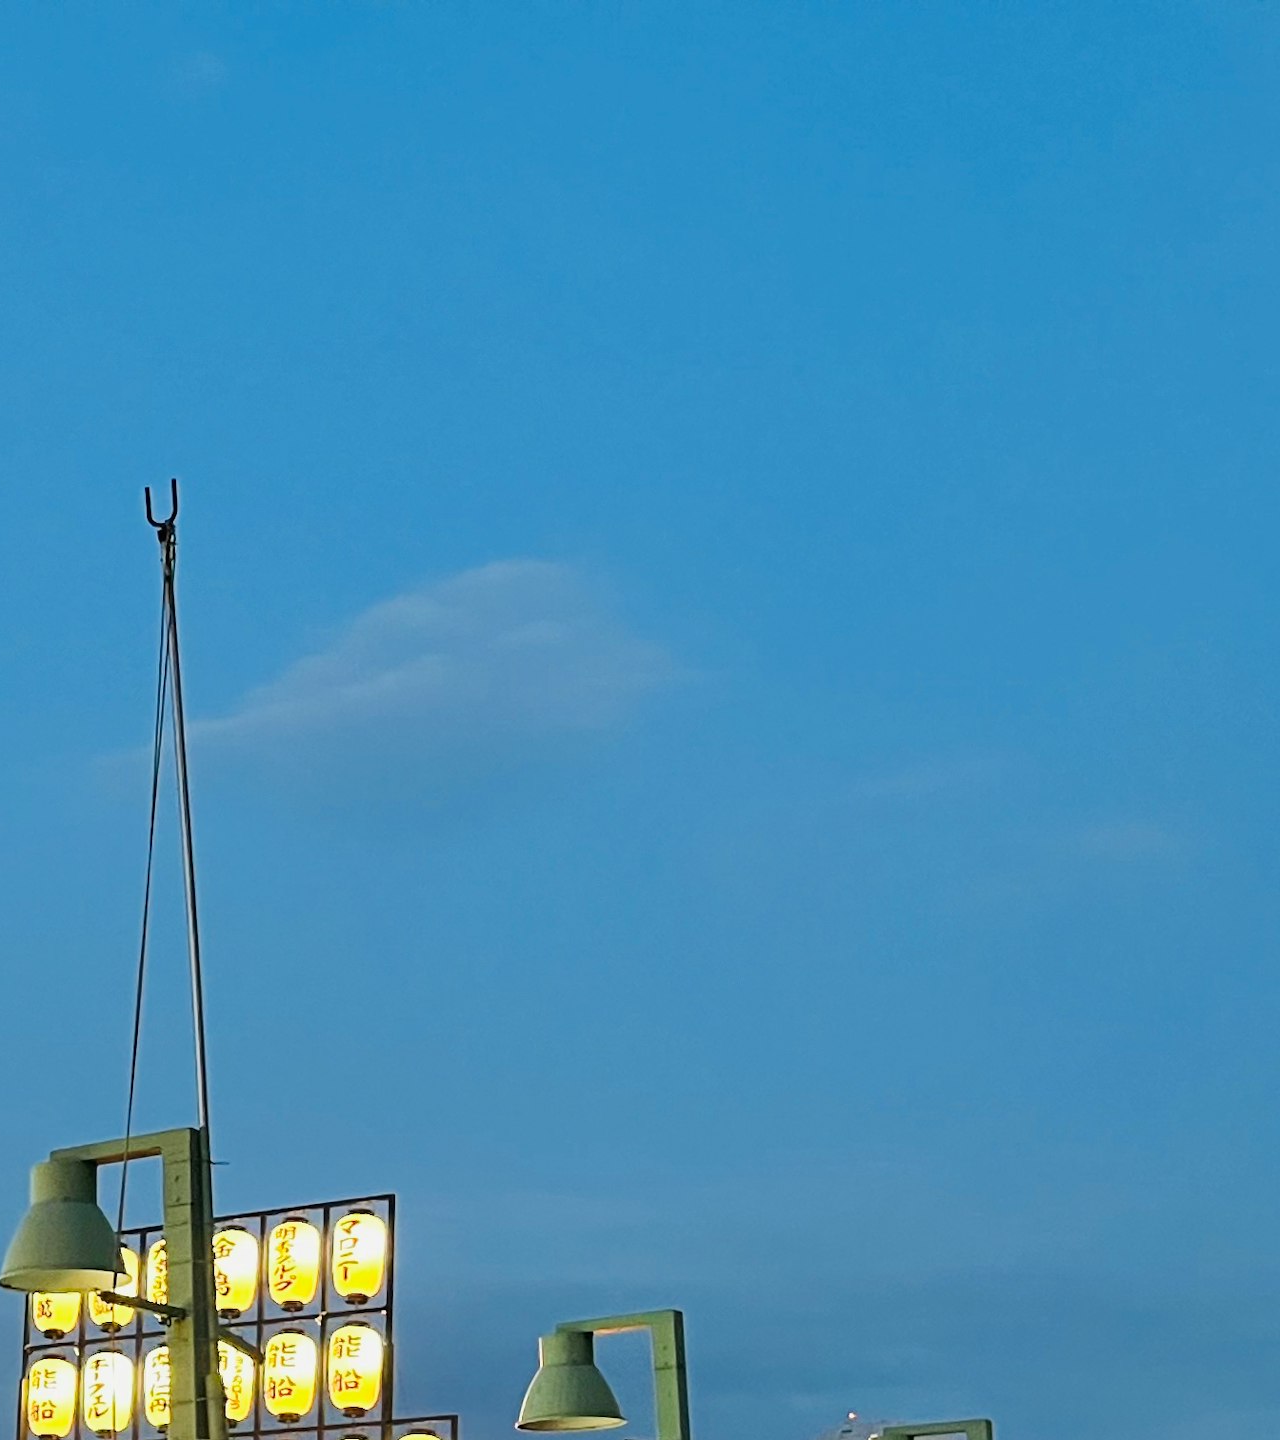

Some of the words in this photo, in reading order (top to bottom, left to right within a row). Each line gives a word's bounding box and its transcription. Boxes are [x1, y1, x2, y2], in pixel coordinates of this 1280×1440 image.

[338, 1219, 360, 1281] マロニー
[268, 1342, 297, 1400] 能船
[333, 1335, 362, 1393] 能船
[31, 1368, 57, 1423] 能船
